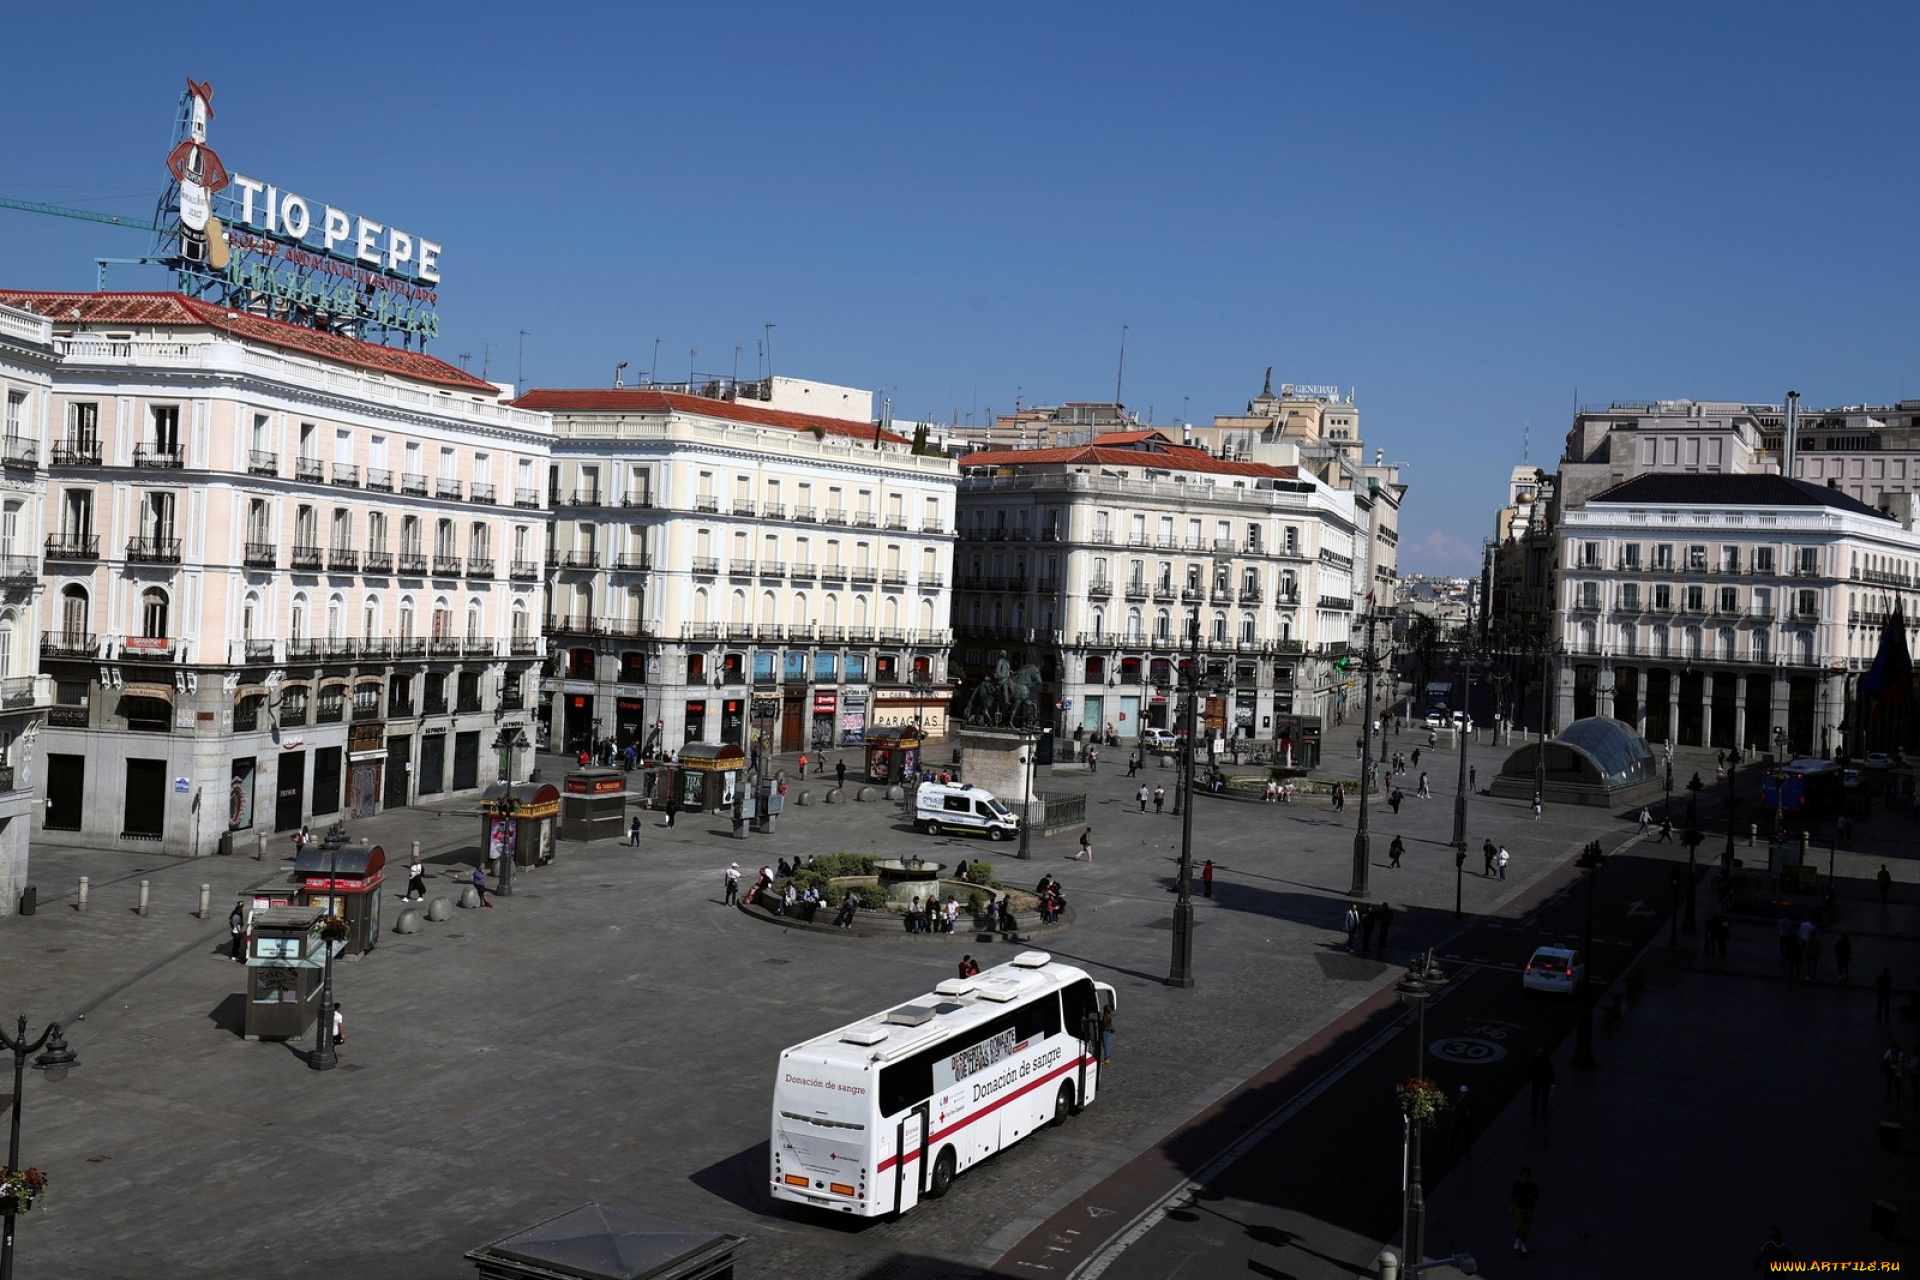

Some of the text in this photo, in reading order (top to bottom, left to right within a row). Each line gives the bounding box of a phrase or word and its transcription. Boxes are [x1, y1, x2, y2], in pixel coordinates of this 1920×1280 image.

[234, 172, 442, 284] TIO PEPE
[1295, 384, 1338, 395] GENERALI
[879, 715, 938, 728] PARAGAS
[1445, 1043, 1489, 1058] 30
[972, 1067, 1017, 1103] Donación
[1019, 1060, 1031, 1078] de
[1033, 1046, 1062, 1072] sangre
[785, 1074, 866, 1096] Donación de sangre
